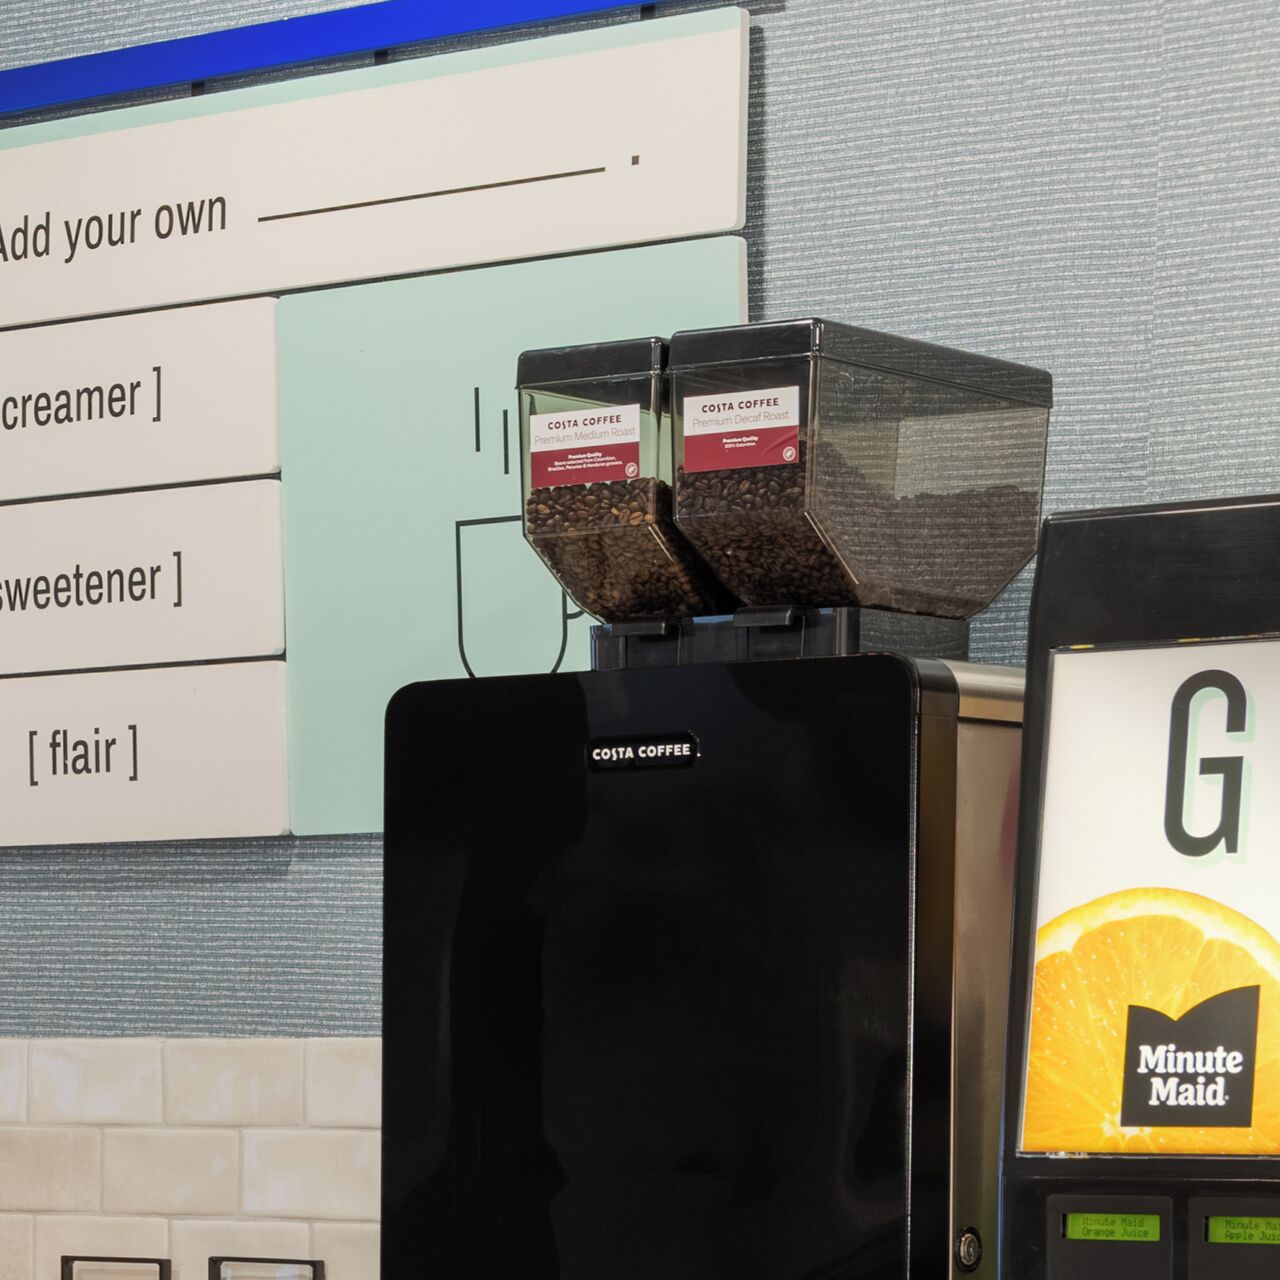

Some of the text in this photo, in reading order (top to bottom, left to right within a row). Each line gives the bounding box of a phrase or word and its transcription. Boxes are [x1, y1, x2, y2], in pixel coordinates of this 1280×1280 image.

[64, 208, 142, 263] your
[154, 196, 226, 239] own
[702, 398, 779, 412] COSTA COFFEE
[548, 415, 622, 430] COSTA COFFEE
[692, 410, 789, 428] Premium Decaf Roast
[534, 427, 636, 444] Premium Medium Roast
[592, 744, 691, 761] COSTA COFFEE
[1164, 669, 1248, 858] G
[1137, 1043, 1244, 1074] Minute
[1148, 1076, 1227, 1106] Maid
[1082, 1216, 1144, 1228] Minute Maid
[1225, 1219, 1280, 1230] Minute Mai
[1082, 1227, 1149, 1238] Orange Juice
[1225, 1229, 1280, 1241] Apple Juic
